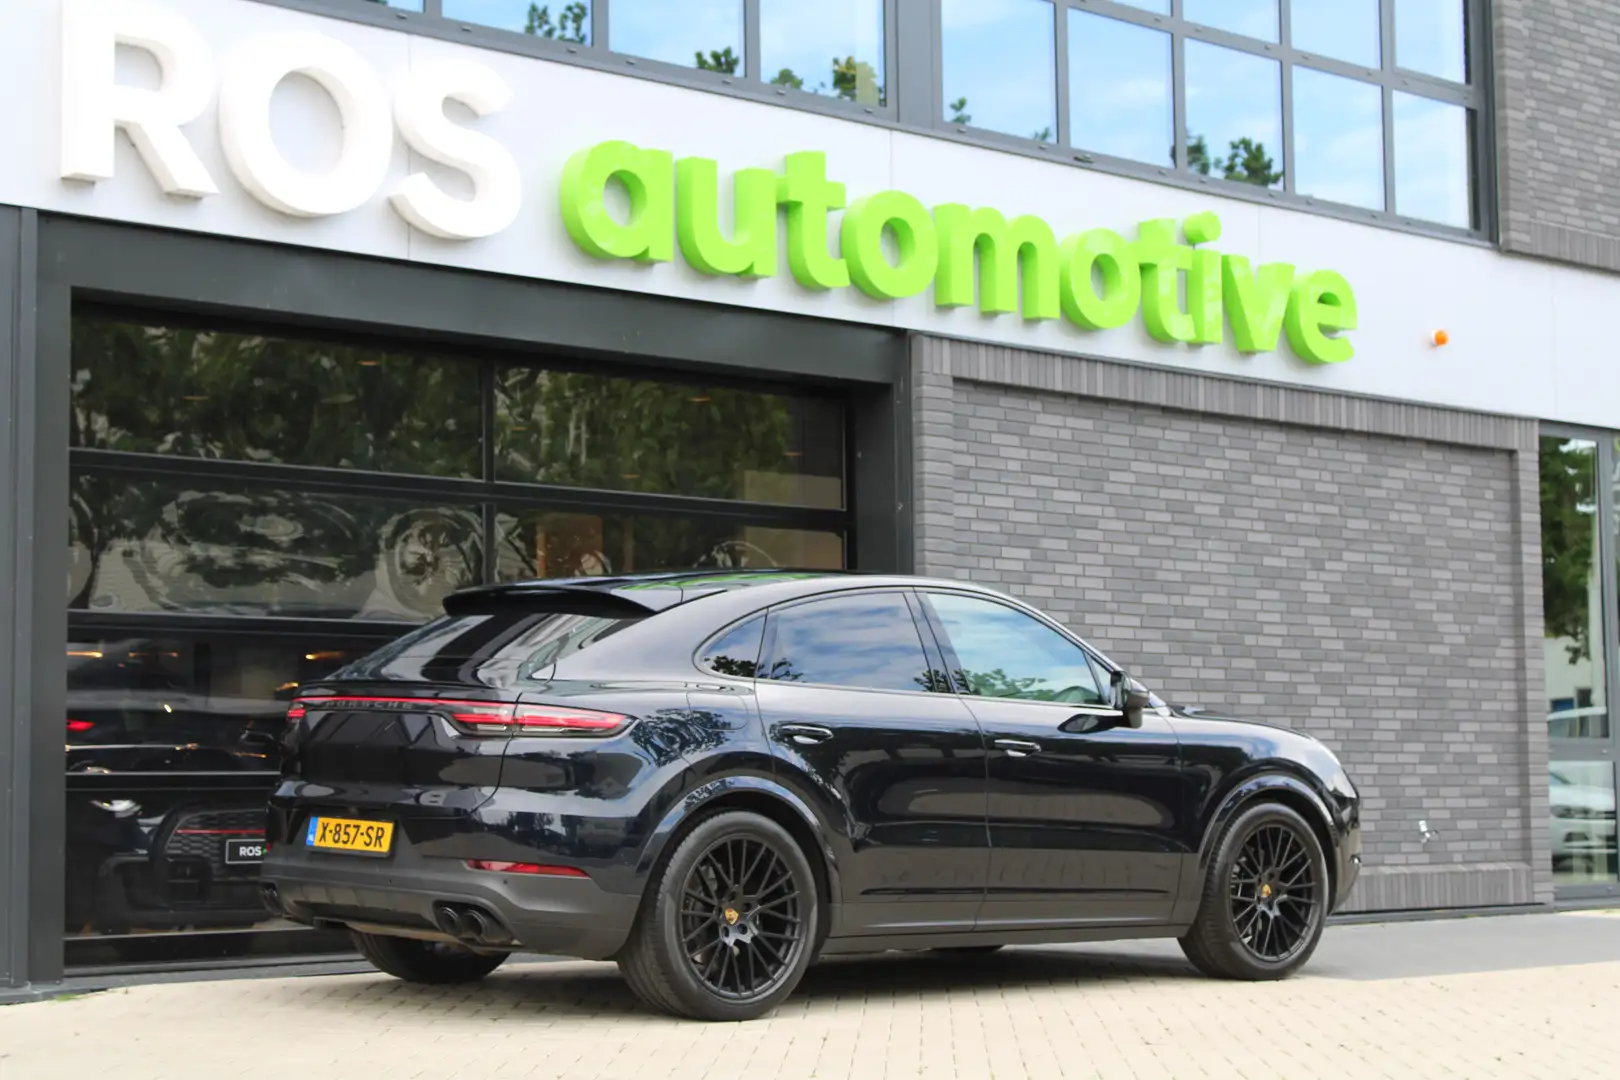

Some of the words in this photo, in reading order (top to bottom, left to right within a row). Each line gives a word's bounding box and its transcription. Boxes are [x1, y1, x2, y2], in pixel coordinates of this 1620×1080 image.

[60, 0, 521, 239] ROS
[559, 140, 1357, 365] automotive
[319, 821, 386, 848] X-857-SR
[239, 845, 262, 857] ROS
